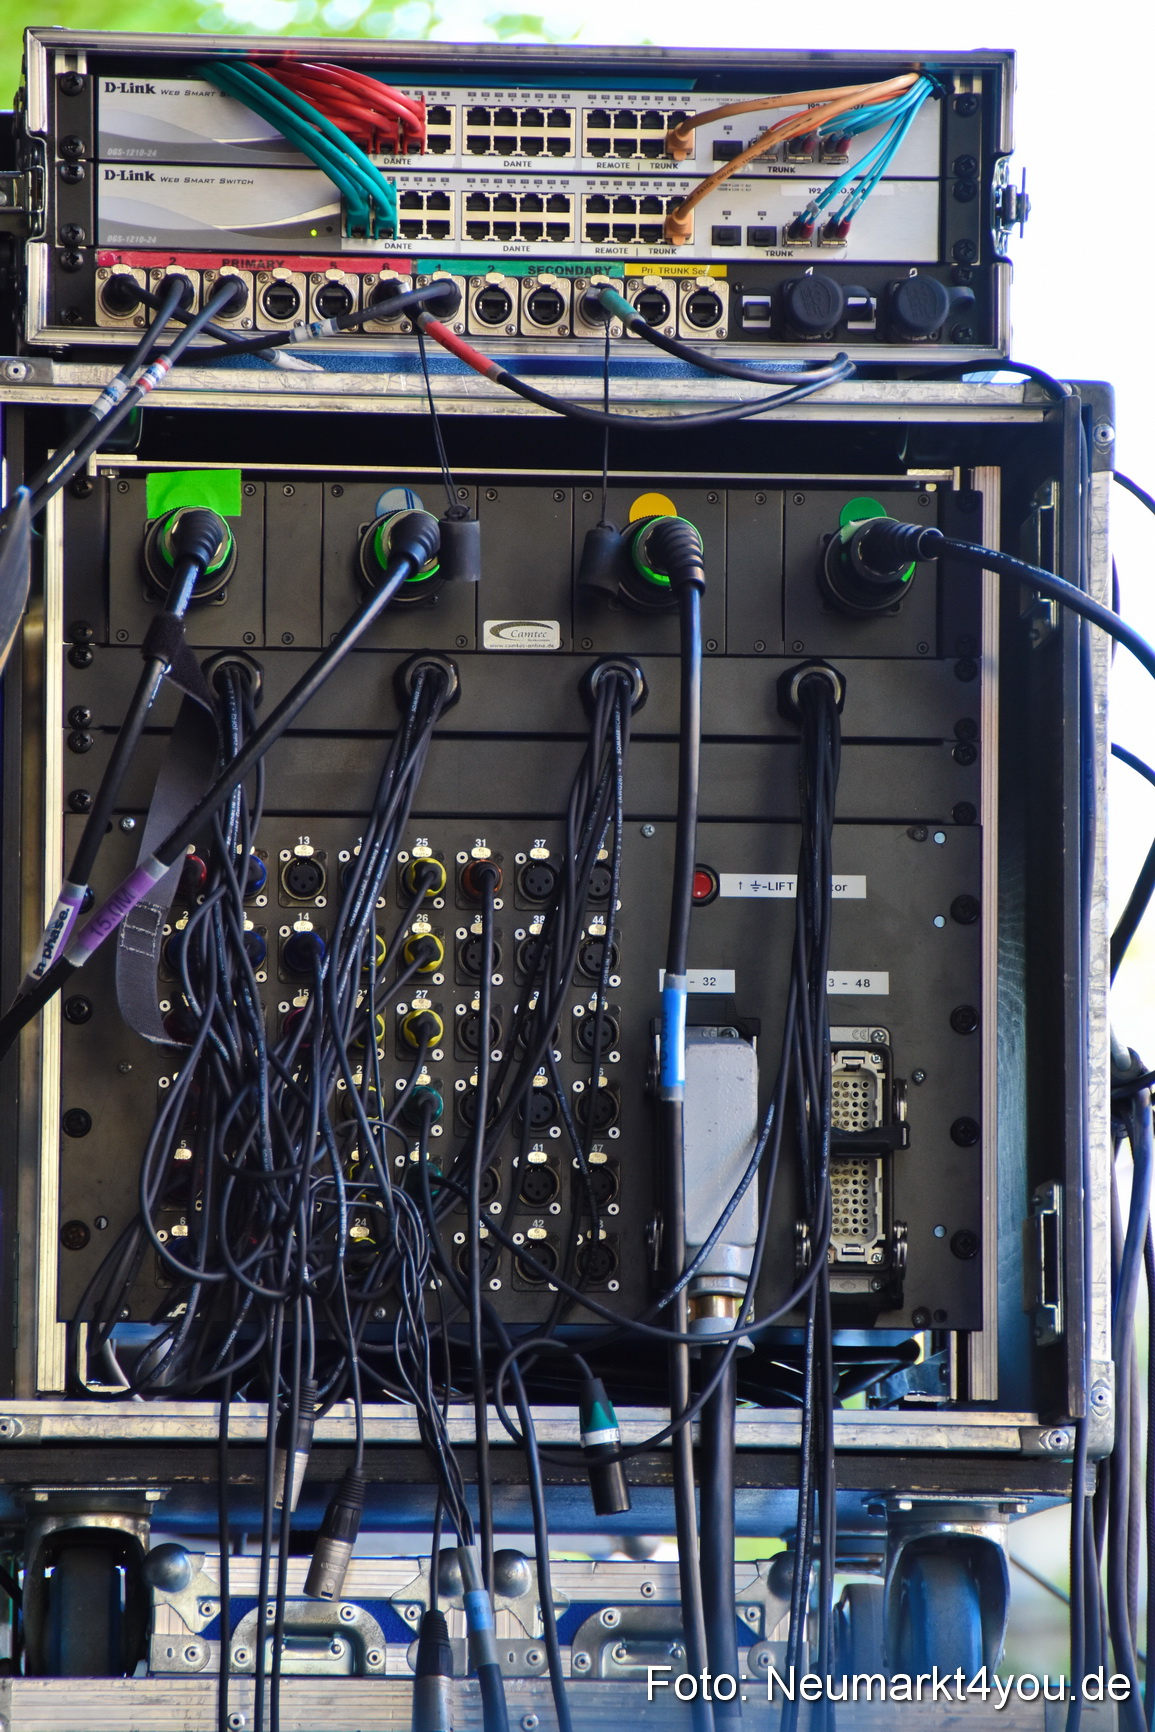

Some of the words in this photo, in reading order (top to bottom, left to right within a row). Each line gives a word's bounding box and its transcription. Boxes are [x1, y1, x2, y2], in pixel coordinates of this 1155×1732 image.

[104, 82, 156, 94] D-Link
[107, 148, 158, 158] DGS-1210-24
[503, 160, 532, 168] DANTE
[650, 162, 679, 170] TRUNK
[767, 166, 796, 174] TRUNK
[104, 169, 156, 182] D-Link
[106, 234, 157, 244] DGS-1210-24
[384, 242, 413, 250] DANTE
[594, 247, 629, 255] REMOTE
[222, 258, 285, 269] PRIMARY
[528, 265, 612, 276] SECONDARY
[658, 266, 690, 275] TRUNK
[298, 836, 310, 845] 13
[416, 838, 429, 846] 25
[475, 839, 486, 847] 31
[534, 839, 546, 848] 37
[365, 848, 379, 876] Germany
[182, 911, 189, 919] 2
[297, 912, 309, 921] 14
[416, 913, 428, 922] 26
[533, 915, 545, 924] 38
[592, 915, 605, 924] 44
[702, 977, 717, 986] 32
[855, 978, 871, 988] 48
[297, 989, 310, 997] 15
[415, 990, 428, 998] 27
[180, 1140, 187, 1148] 5
[532, 1143, 544, 1152] 41
[592, 1144, 604, 1152] 47
[180, 1217, 186, 1225] 6
[354, 1217, 367, 1226] 24
[532, 1219, 544, 1228] 42
[674, 1269, 695, 1293] GOBLIN
